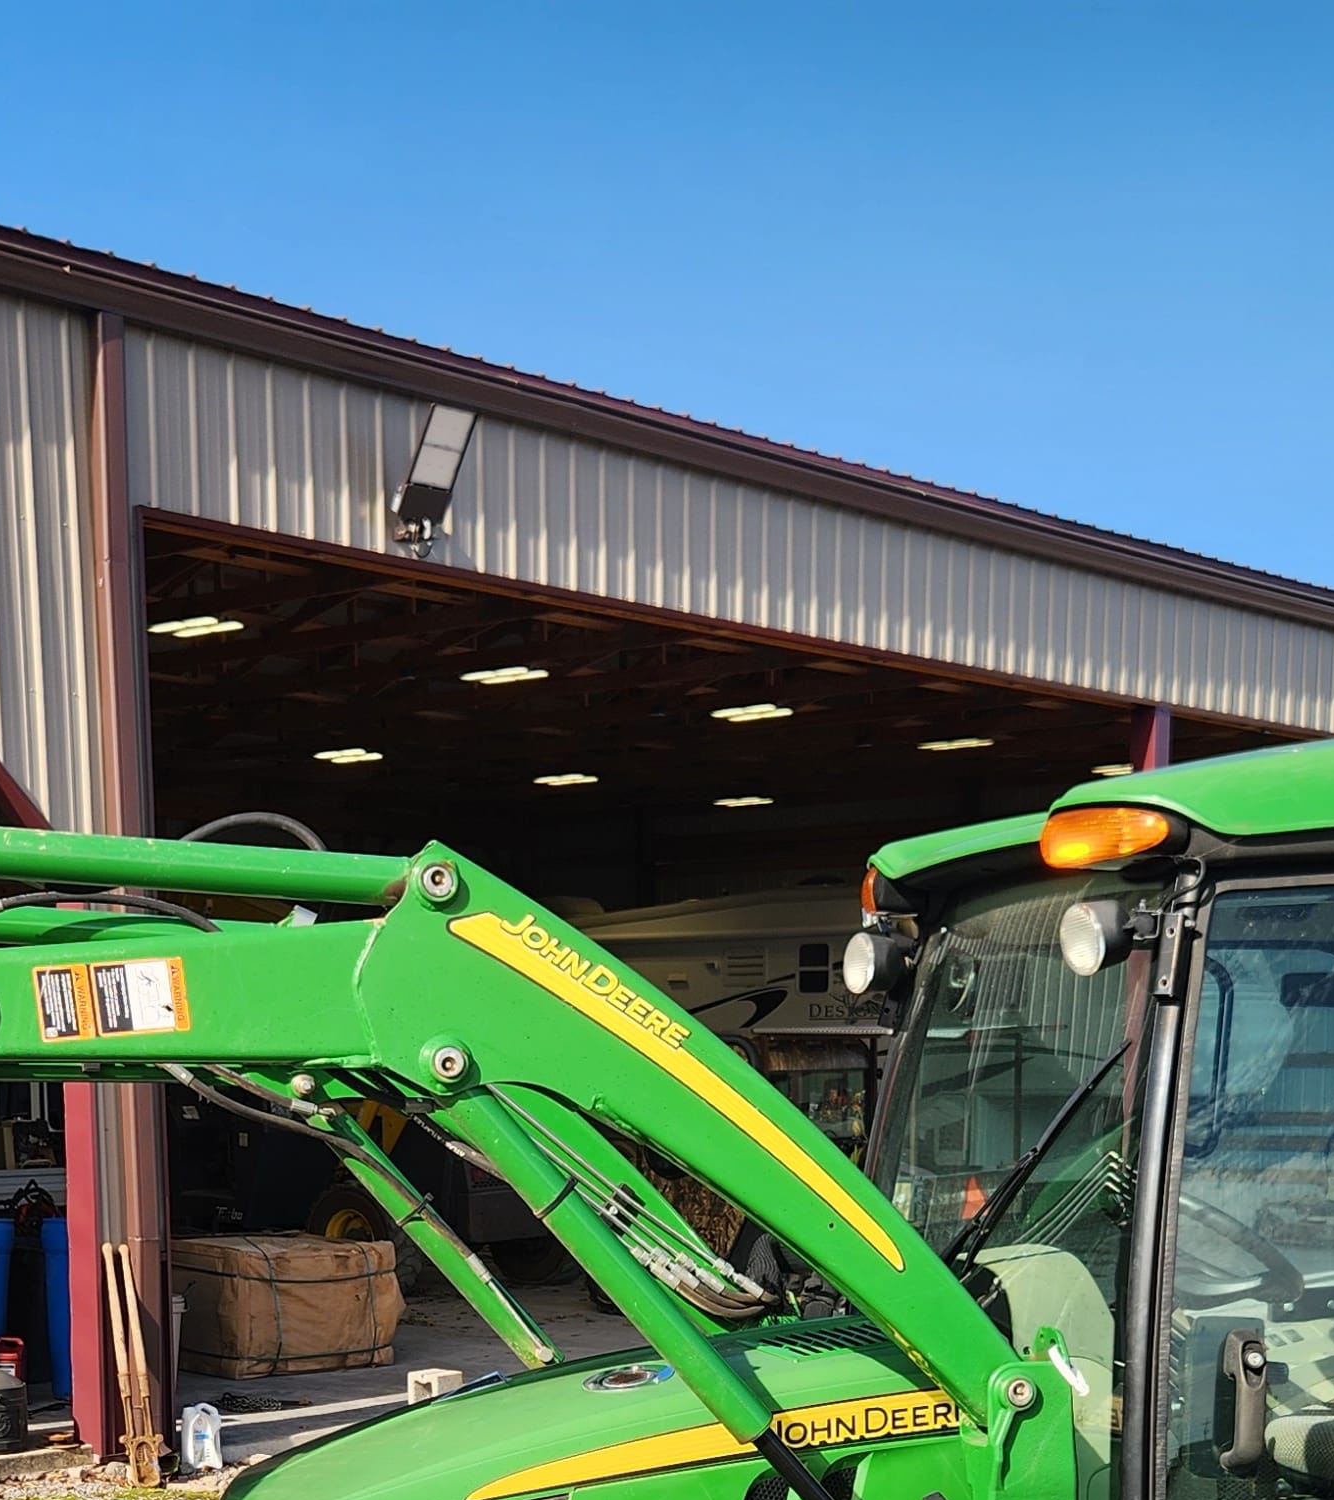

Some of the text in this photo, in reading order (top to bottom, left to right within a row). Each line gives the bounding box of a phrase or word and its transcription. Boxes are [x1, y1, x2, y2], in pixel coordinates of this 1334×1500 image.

[170, 975, 186, 1022] WARNING
[500, 913, 692, 1047] JOHN DEERE
[74, 985, 92, 1031] WARNING
[216, 1206, 243, 1221] Tbo
[864, 1401, 960, 1434] DEER
